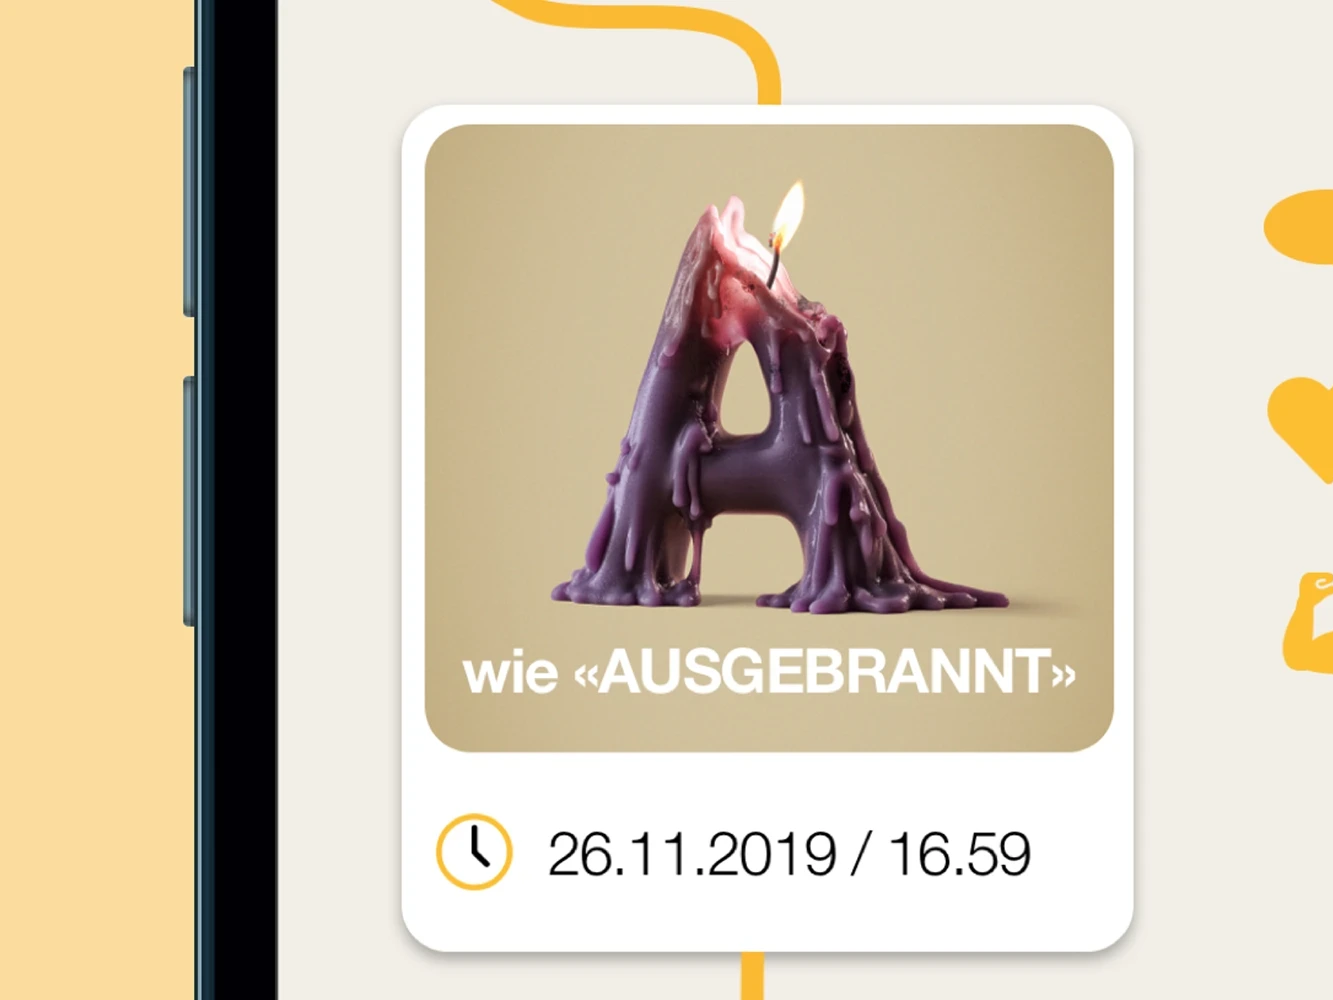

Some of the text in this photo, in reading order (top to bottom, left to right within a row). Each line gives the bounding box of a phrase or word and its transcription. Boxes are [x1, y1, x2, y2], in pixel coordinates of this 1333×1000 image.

[462, 646, 1077, 695] wie «AUSGEBRANNT»
[548, 830, 836, 878] 26.11.2019
[890, 830, 1032, 878] 16.59
